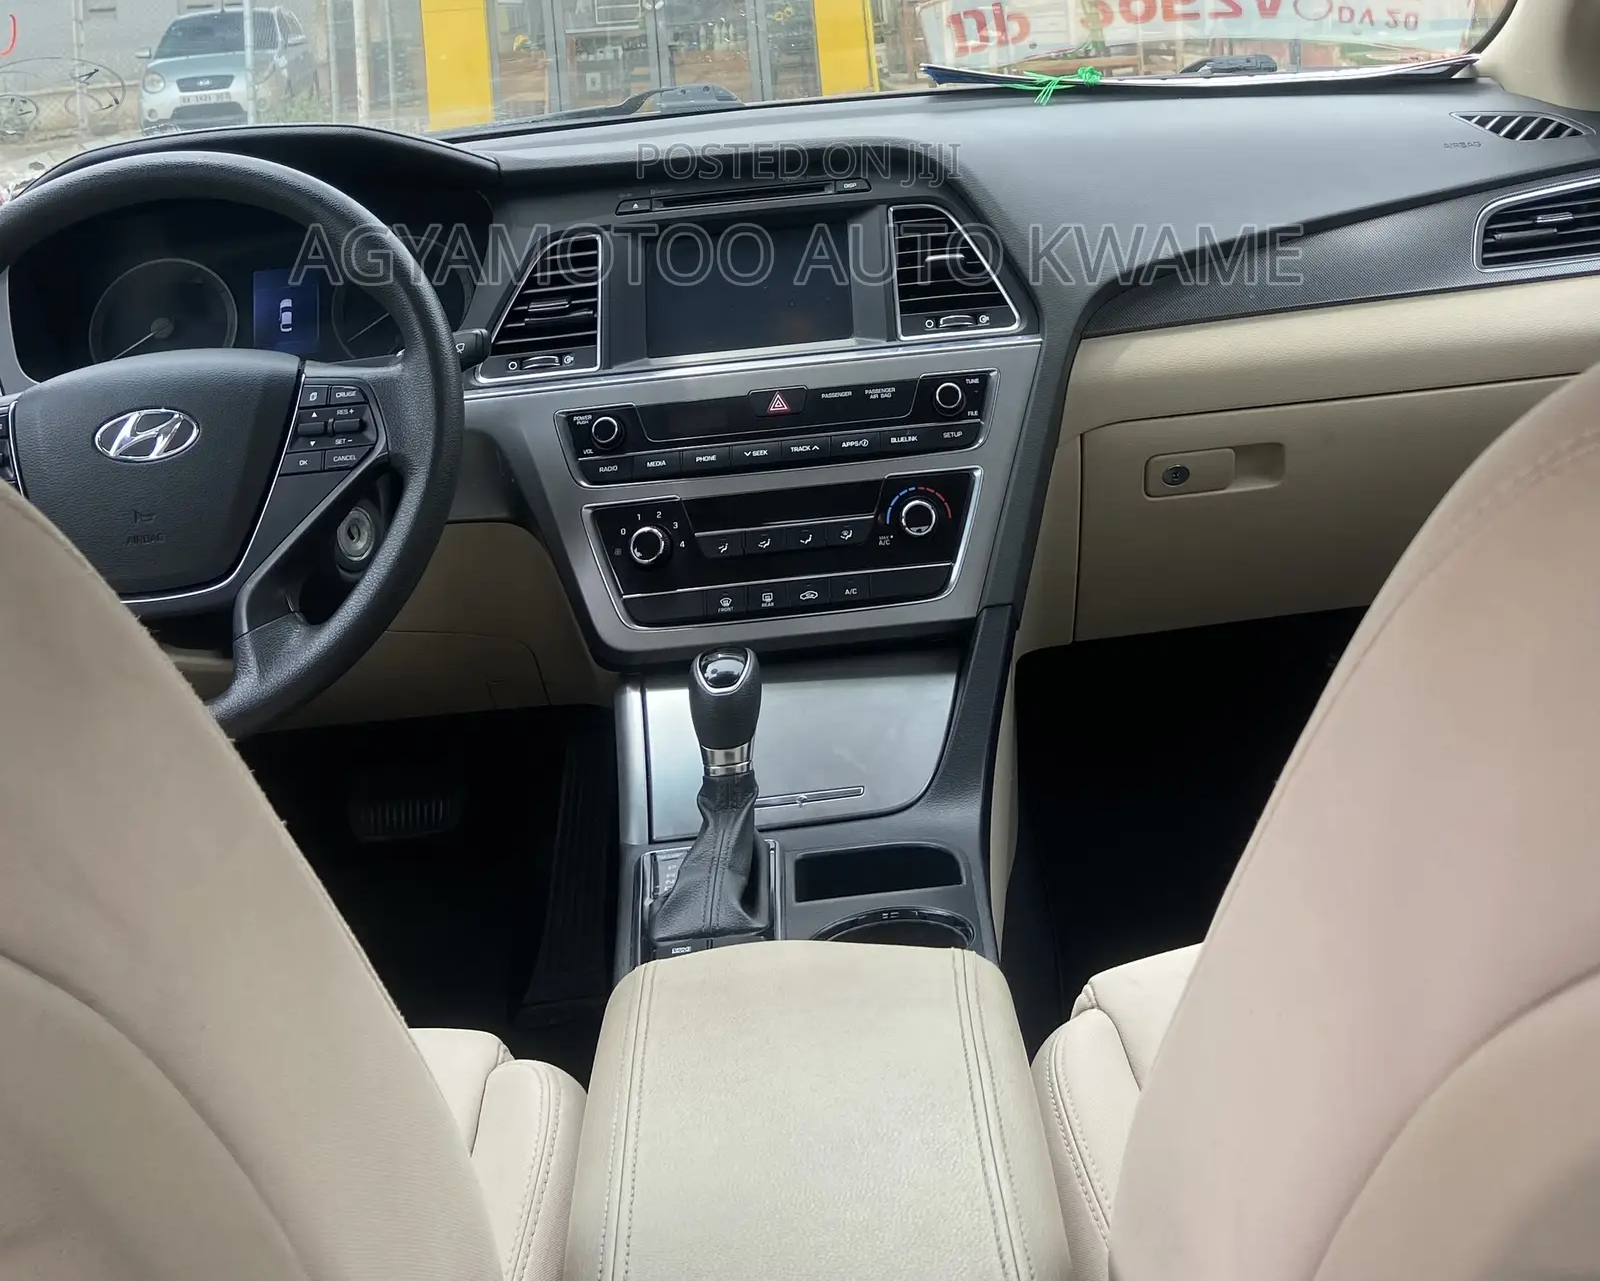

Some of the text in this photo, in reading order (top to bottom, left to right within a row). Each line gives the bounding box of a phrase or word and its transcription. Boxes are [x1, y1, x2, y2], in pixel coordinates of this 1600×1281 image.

[1443, 141, 1482, 149] AIRBAG
[335, 390, 357, 398] CRUISE
[821, 391, 852, 399] PASSENGER
[865, 387, 896, 395] PASSENGER
[573, 414, 593, 422] POWER
[942, 430, 963, 439] SETUP
[890, 435, 918, 444] BLUELINK
[752, 449, 768, 457] SEEK
[790, 445, 811, 453] TRACK
[333, 454, 357, 462] CANCEL
[695, 454, 717, 463] PHONE
[646, 459, 667, 468] MEDIA
[599, 464, 618, 473] RADIO
[636, 513, 641, 521] 1
[656, 510, 662, 519] 2
[672, 521, 679, 529] 3
[620, 527, 627, 535] 0
[679, 540, 686, 548] 4
[878, 538, 891, 546] A/C
